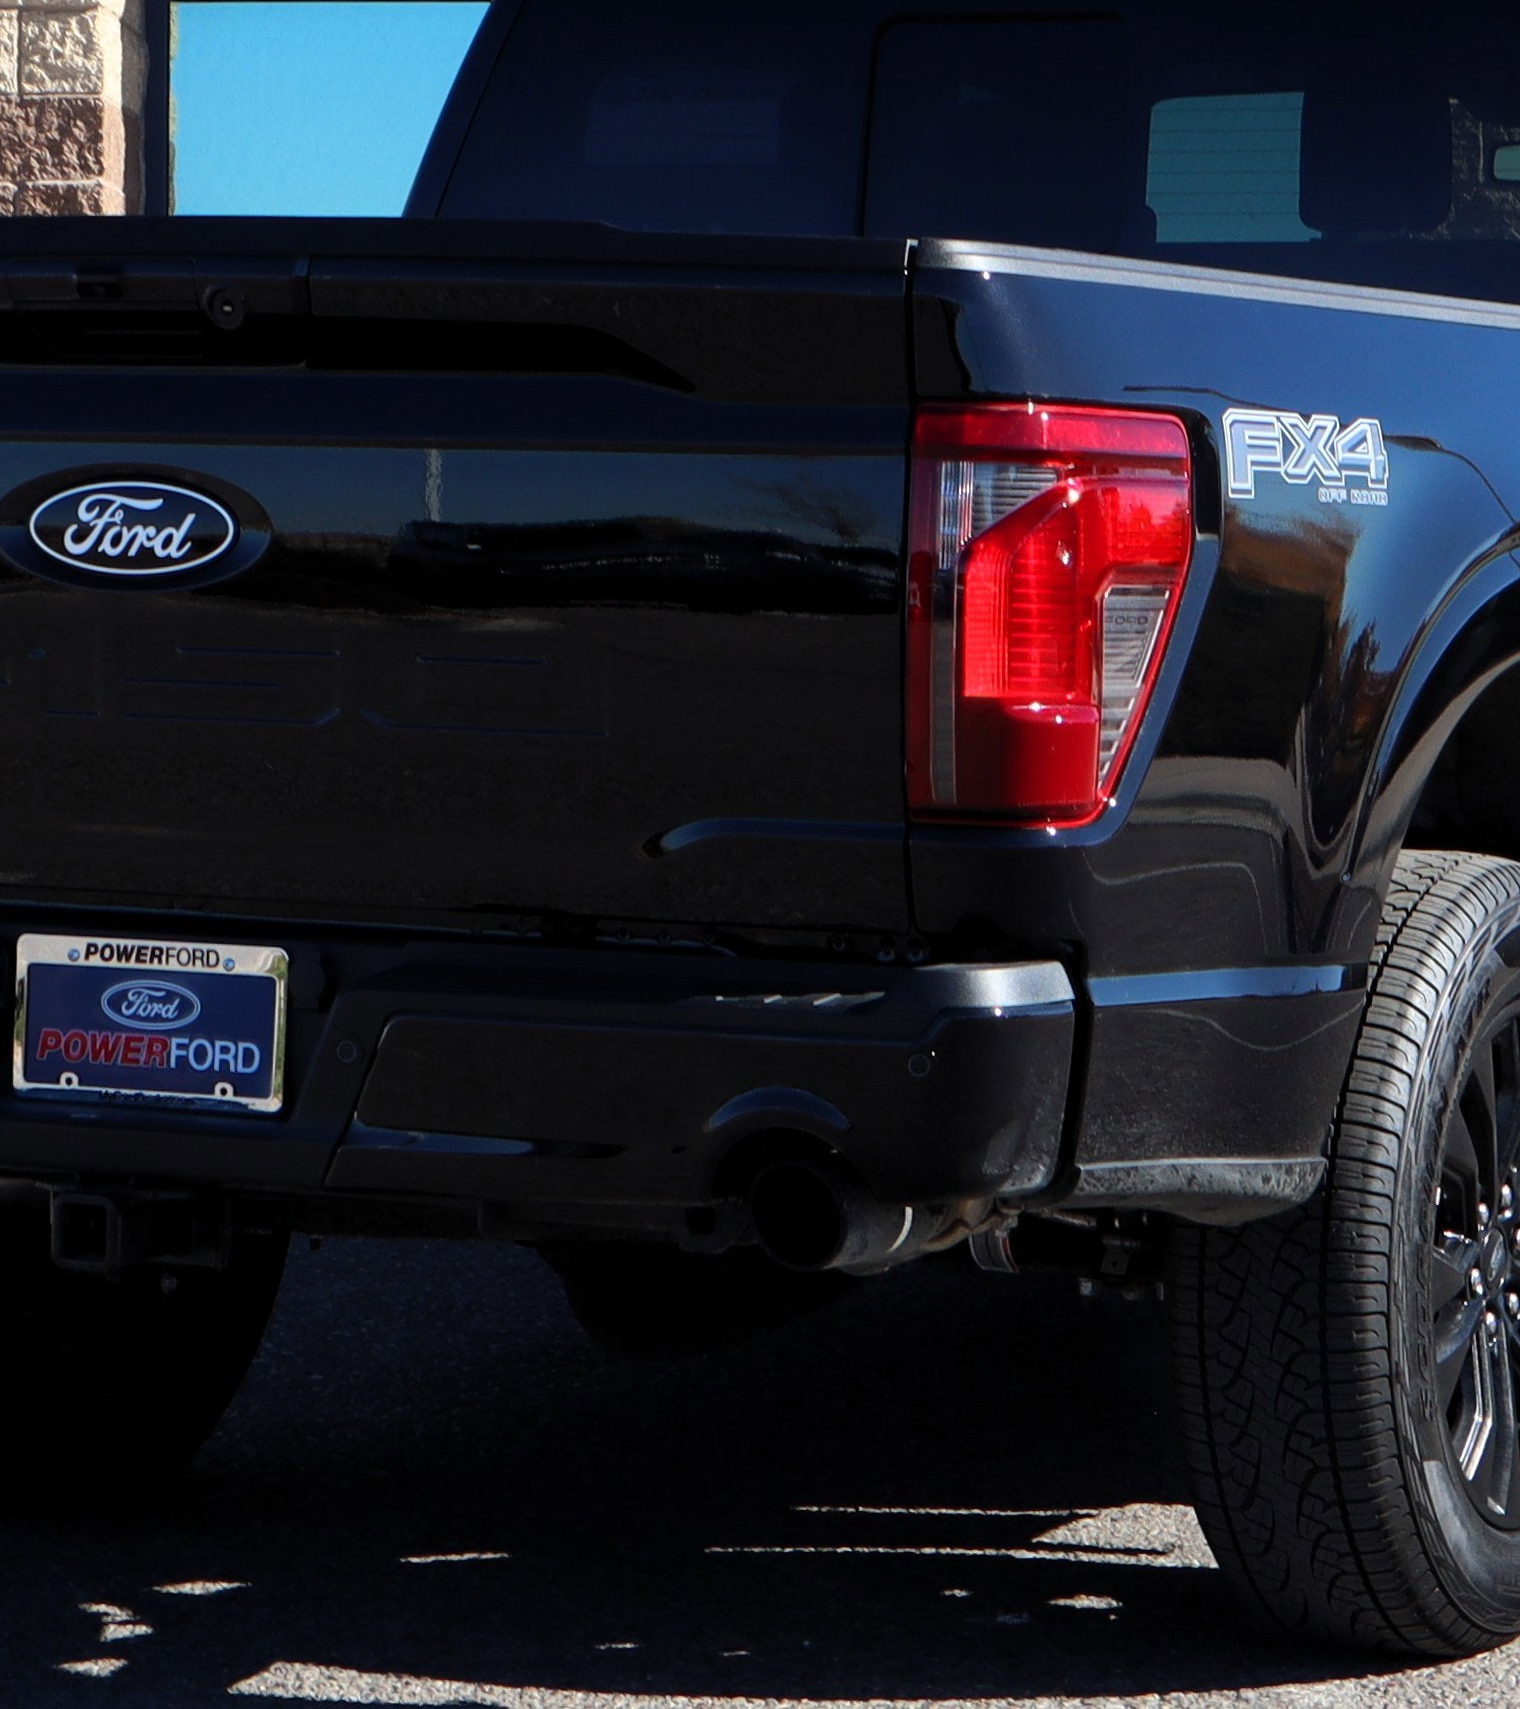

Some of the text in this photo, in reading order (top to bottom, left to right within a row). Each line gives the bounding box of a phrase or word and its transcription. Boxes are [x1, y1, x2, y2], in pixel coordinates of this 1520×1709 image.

[1222, 407, 1389, 499] FX4
[64, 494, 195, 559] Ford
[84, 942, 221, 969] POWERFORD
[121, 988, 181, 1020] Ford
[36, 1028, 261, 1074] POWERFORD
